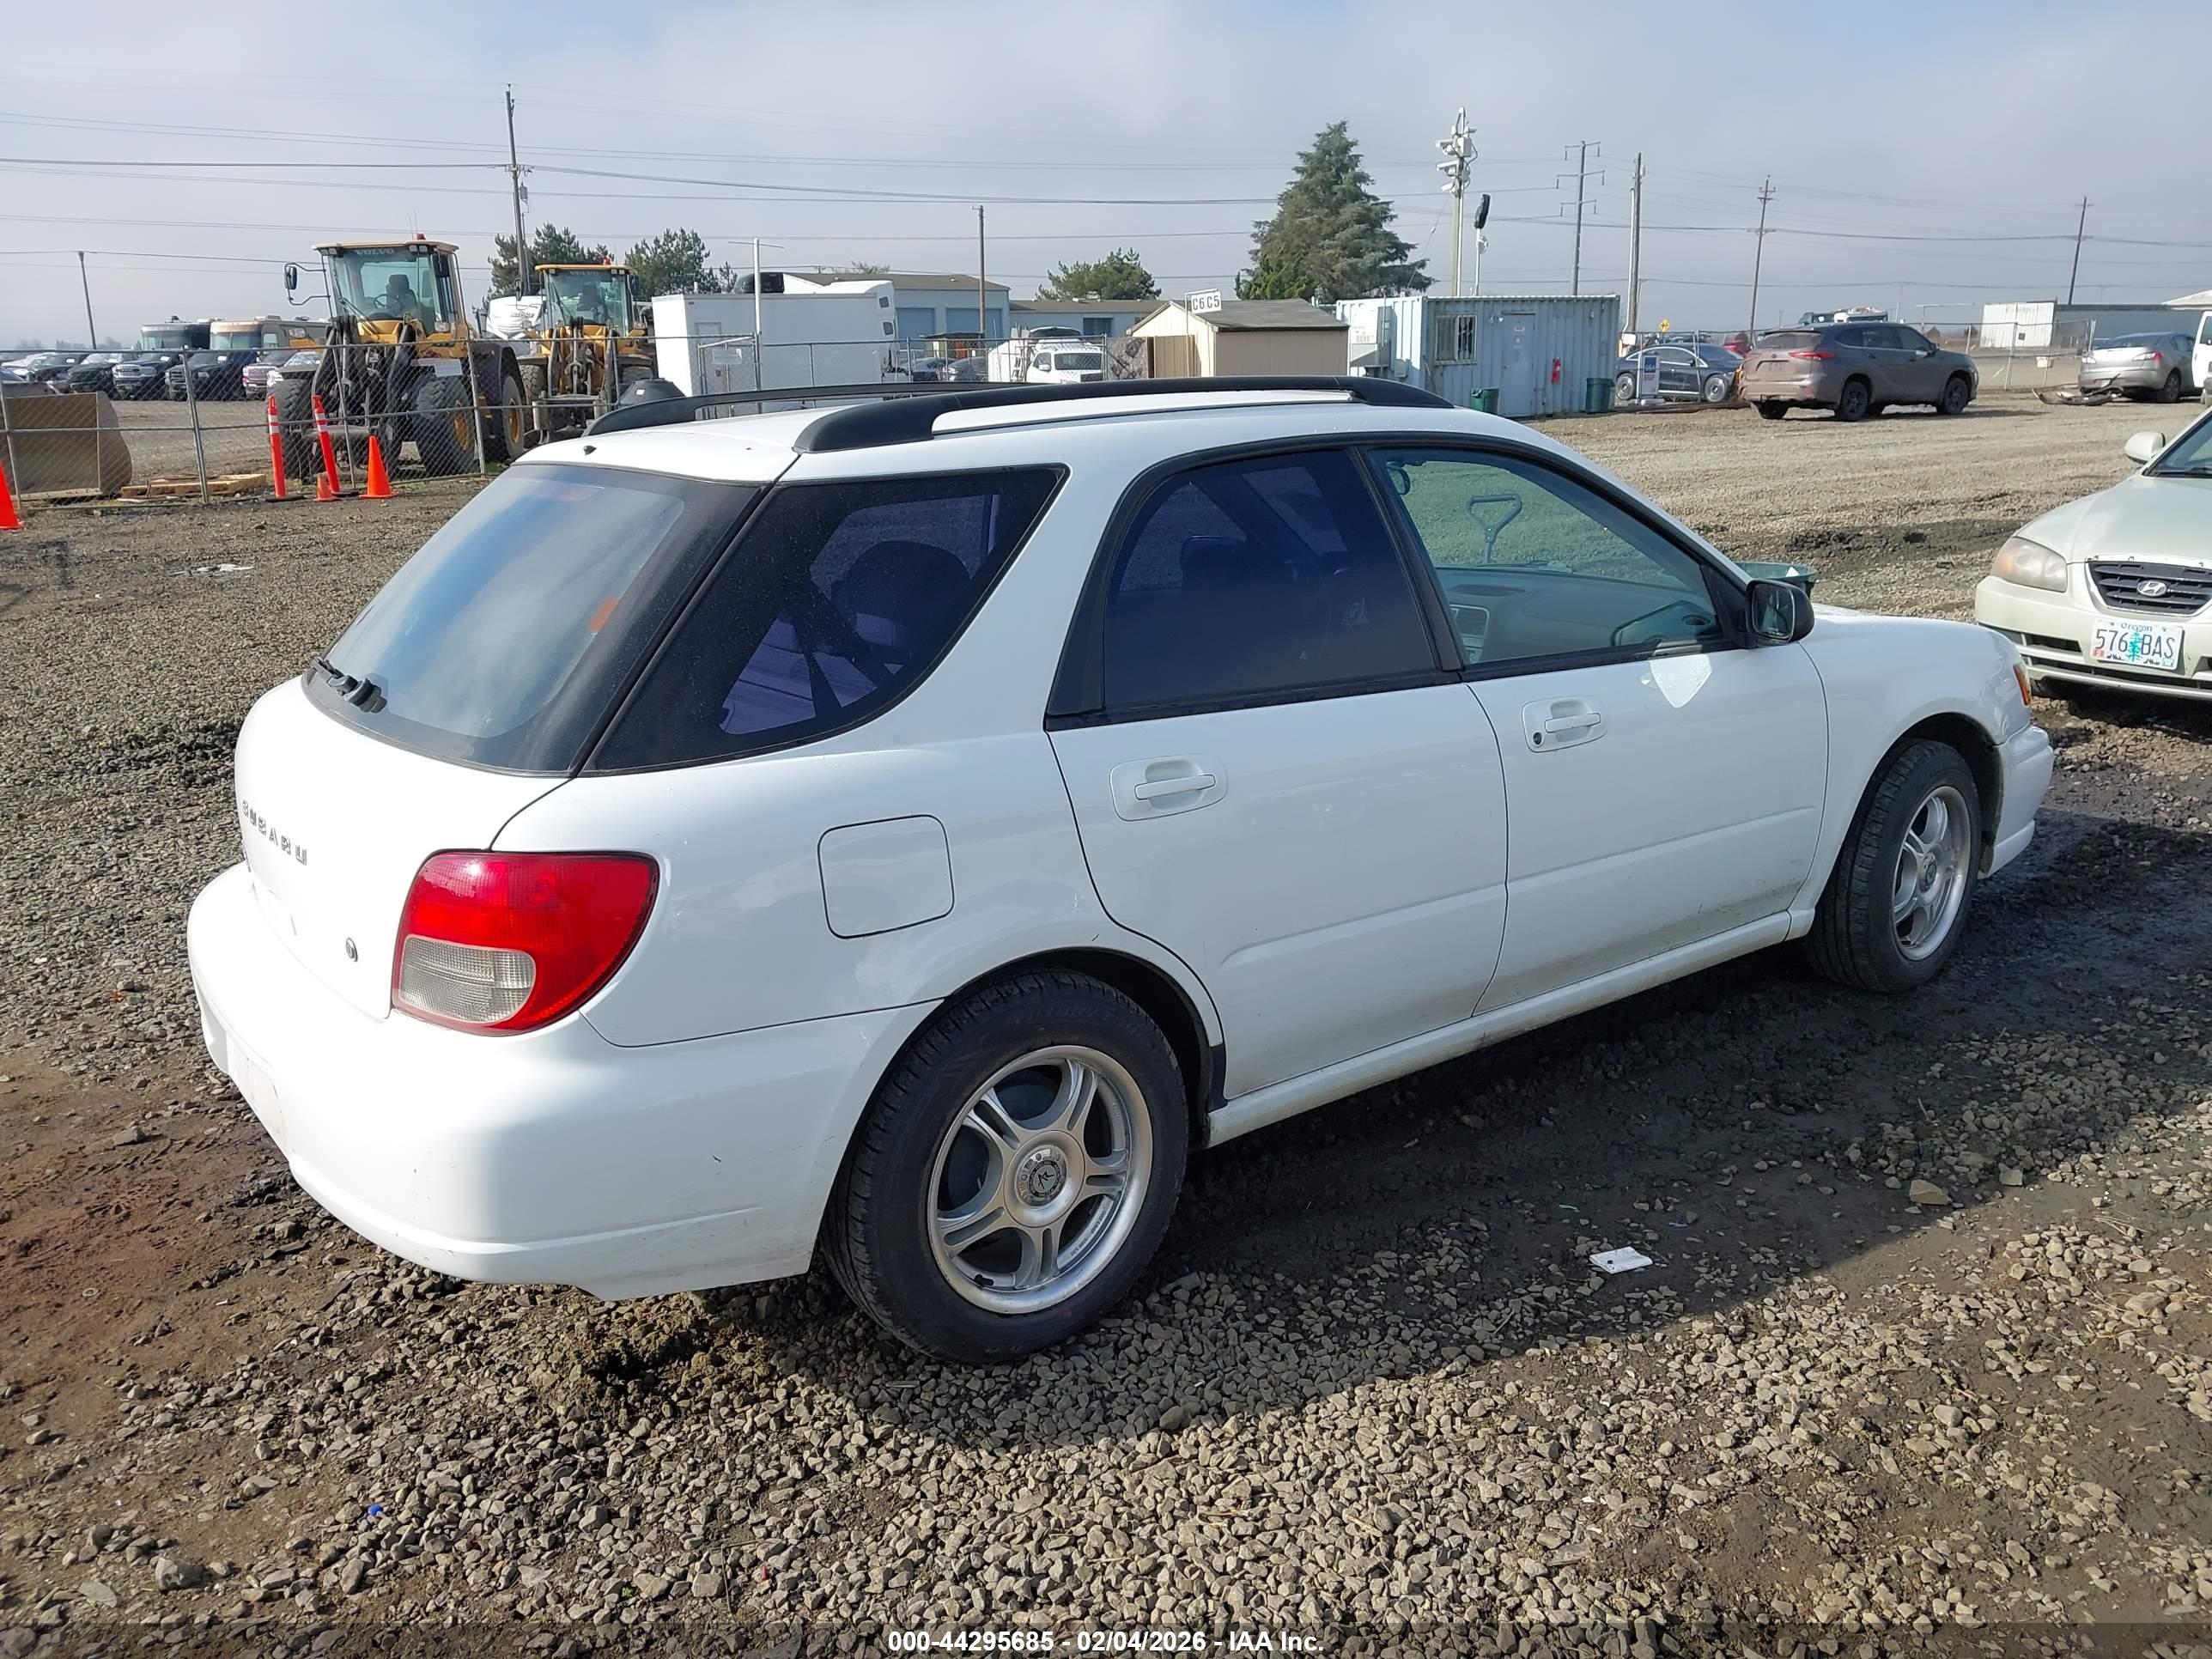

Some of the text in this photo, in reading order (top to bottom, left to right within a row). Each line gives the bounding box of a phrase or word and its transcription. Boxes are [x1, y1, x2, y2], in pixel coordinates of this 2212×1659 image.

[2120, 622, 2153, 632] Oregon
[2095, 629, 2176, 659] 576 BAS
[241, 799, 307, 866] SUBARU
